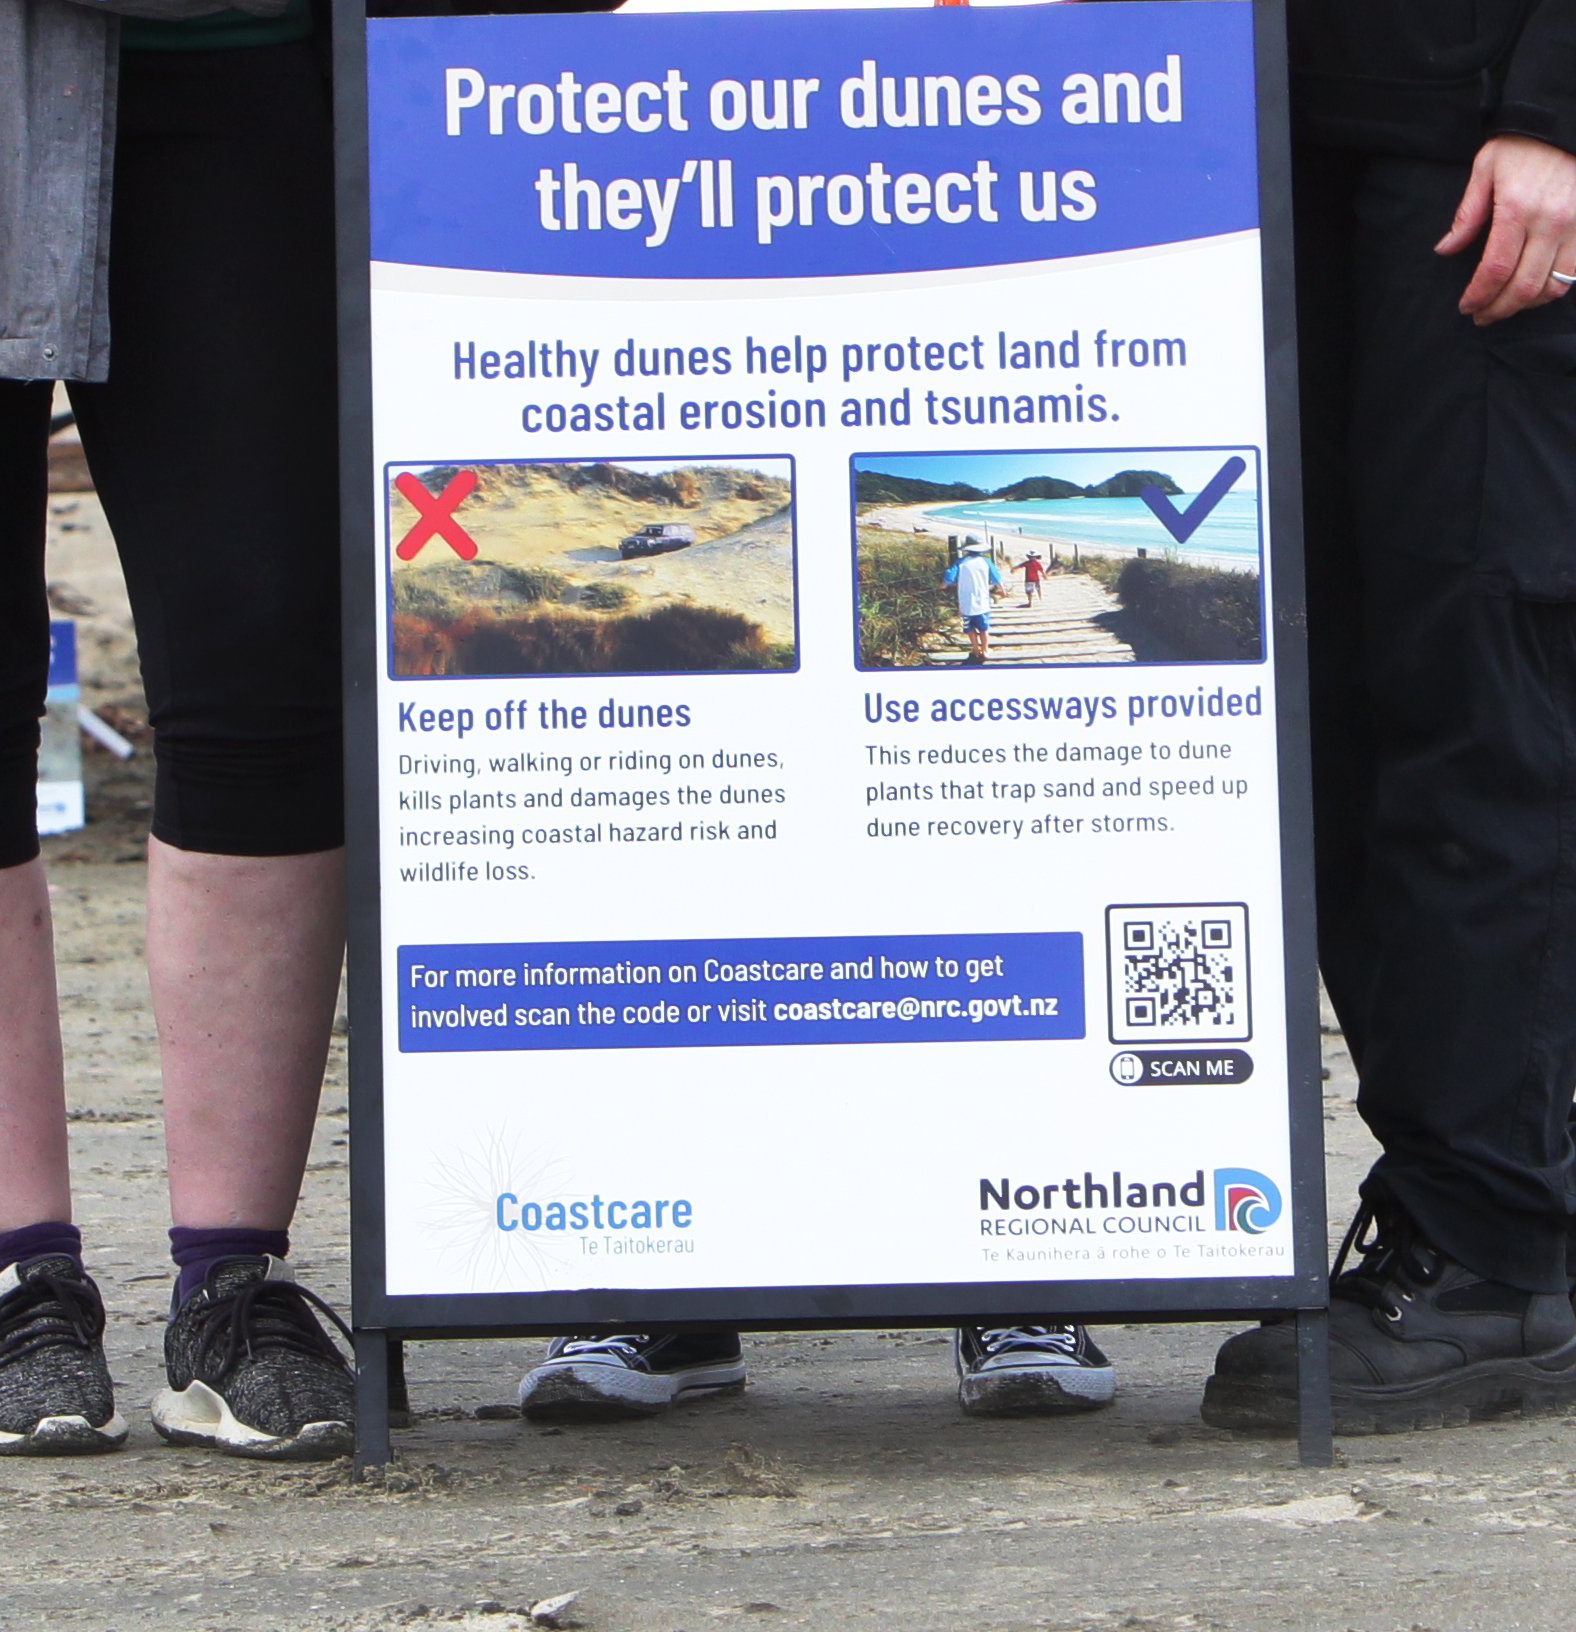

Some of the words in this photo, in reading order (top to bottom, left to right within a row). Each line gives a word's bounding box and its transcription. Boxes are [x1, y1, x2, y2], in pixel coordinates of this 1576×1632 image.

[446, 68, 688, 135] Protect
[710, 79, 819, 131] our
[841, 60, 1041, 128] dunes
[1062, 55, 1181, 124] and
[757, 161, 998, 244] protect
[1020, 171, 1096, 221] us
[454, 340, 599, 387] Healthy
[615, 339, 731, 376] dunes
[747, 335, 826, 383] help
[843, 335, 984, 382] protect
[999, 330, 1079, 369] land
[1094, 329, 1186, 367] from
[522, 392, 664, 432] coastal
[680, 389, 825, 430] erosion
[841, 388, 910, 427] and
[925, 384, 1119, 425] tsunamis.
[399, 702, 473, 739] Keep
[486, 700, 527, 730] off
[539, 699, 587, 729] the
[599, 698, 690, 728] dunes
[865, 693, 919, 723] Use
[931, 697, 1116, 727] accessways
[1129, 686, 1261, 726] provided
[400, 754, 480, 778] Driving,
[489, 752, 572, 776] walking
[580, 757, 601, 771] or
[610, 750, 671, 774] riding
[679, 754, 704, 769] on
[713, 749, 783, 768] dunes,
[866, 746, 910, 765] This
[919, 745, 1006, 764] reduces
[1014, 743, 1048, 762] the
[1056, 742, 1142, 765] damage
[1150, 743, 1170, 759] to
[1179, 740, 1231, 759] dune
[400, 791, 441, 809] kills
[450, 790, 516, 814] plants
[524, 788, 562, 808] and
[571, 788, 670, 811] damages
[678, 786, 712, 804] the
[720, 785, 785, 804] dunes
[867, 782, 933, 806] plants
[941, 780, 983, 799] that
[992, 782, 1035, 803] trap
[1044, 778, 1094, 797] sand
[1103, 777, 1141, 796] and
[1149, 776, 1214, 800] speed
[1223, 780, 1247, 798] up
[401, 825, 514, 849] increasing
[522, 823, 601, 844] coastal
[610, 822, 682, 842] hazard
[691, 821, 729, 840] risk
[738, 820, 776, 839] and
[867, 818, 920, 837] dune
[928, 820, 1023, 839] recovery
[1031, 814, 1083, 834] after
[1092, 815, 1173, 832] storms.
[400, 862, 478, 881] wildlife
[487, 862, 535, 880] loss.
[412, 965, 448, 987] For
[456, 969, 516, 987] more
[524, 961, 660, 985] information
[669, 966, 696, 983] on
[705, 959, 823, 982] Coastcare
[831, 956, 872, 979] and
[881, 956, 928, 979] how
[935, 957, 958, 977] to
[966, 956, 1003, 982] get
[412, 1003, 507, 1028] involved
[515, 1008, 569, 1025] scan
[578, 1002, 615, 1024] the
[623, 1001, 679, 1023] code
[688, 1005, 711, 1022] or
[718, 999, 767, 1021] visit
[774, 995, 1058, 1022] coastcare@nrc.govt.nz
[1151, 1061, 1200, 1077] SCAN
[1207, 1060, 1233, 1075] ME
[980, 1170, 1204, 1210] Northland
[497, 1193, 692, 1231] Coastcare
[981, 1218, 1096, 1235] REGIONAL
[1103, 1216, 1205, 1233] COUNCIL
[580, 1237, 598, 1254] Te
[604, 1236, 694, 1254] Taitokerau
[982, 1247, 999, 1261] Te
[1007, 1245, 1089, 1261] Kaunihera
[1113, 1244, 1149, 1259] rohe
[1173, 1243, 1190, 1257] Te
[1198, 1242, 1284, 1257] Taitokerau
